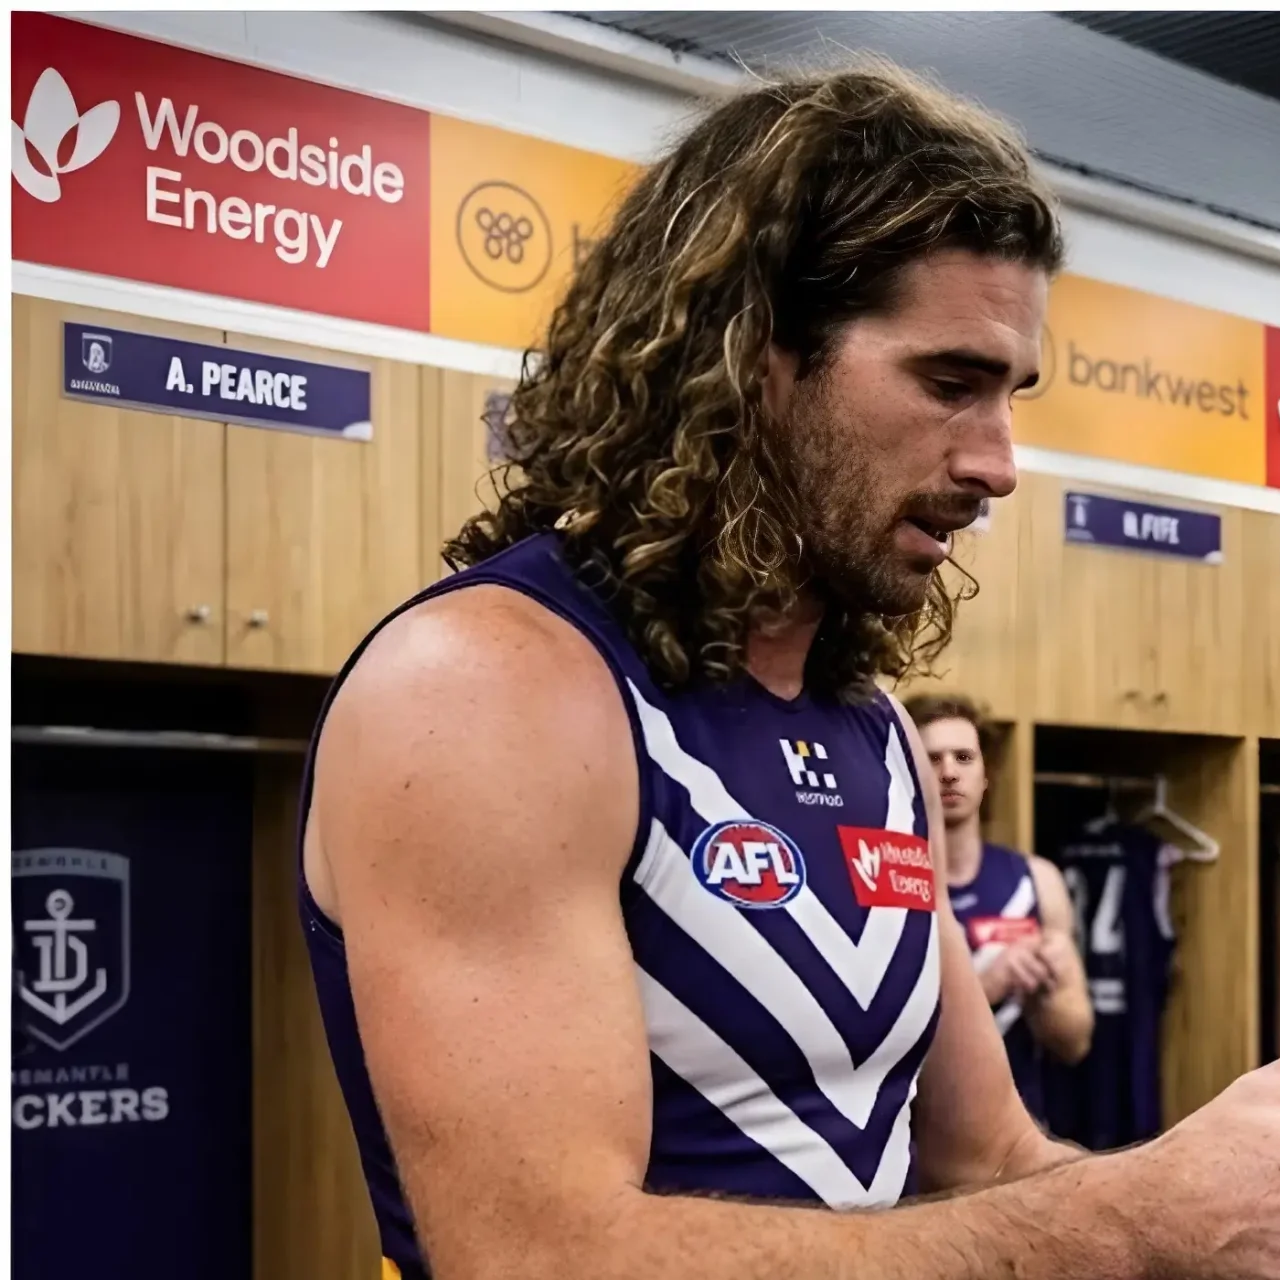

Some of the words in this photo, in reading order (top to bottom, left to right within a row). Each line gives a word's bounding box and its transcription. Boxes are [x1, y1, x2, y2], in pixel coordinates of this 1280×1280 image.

[134, 91, 405, 205] Woodside
[145, 166, 343, 268] Energy
[165, 356, 194, 395] A.
[201, 360, 308, 411] PEARCE
[1067, 341, 1251, 422] bankwest
[706, 840, 800, 887] AFL
[12, 1086, 170, 1130] CKERS
